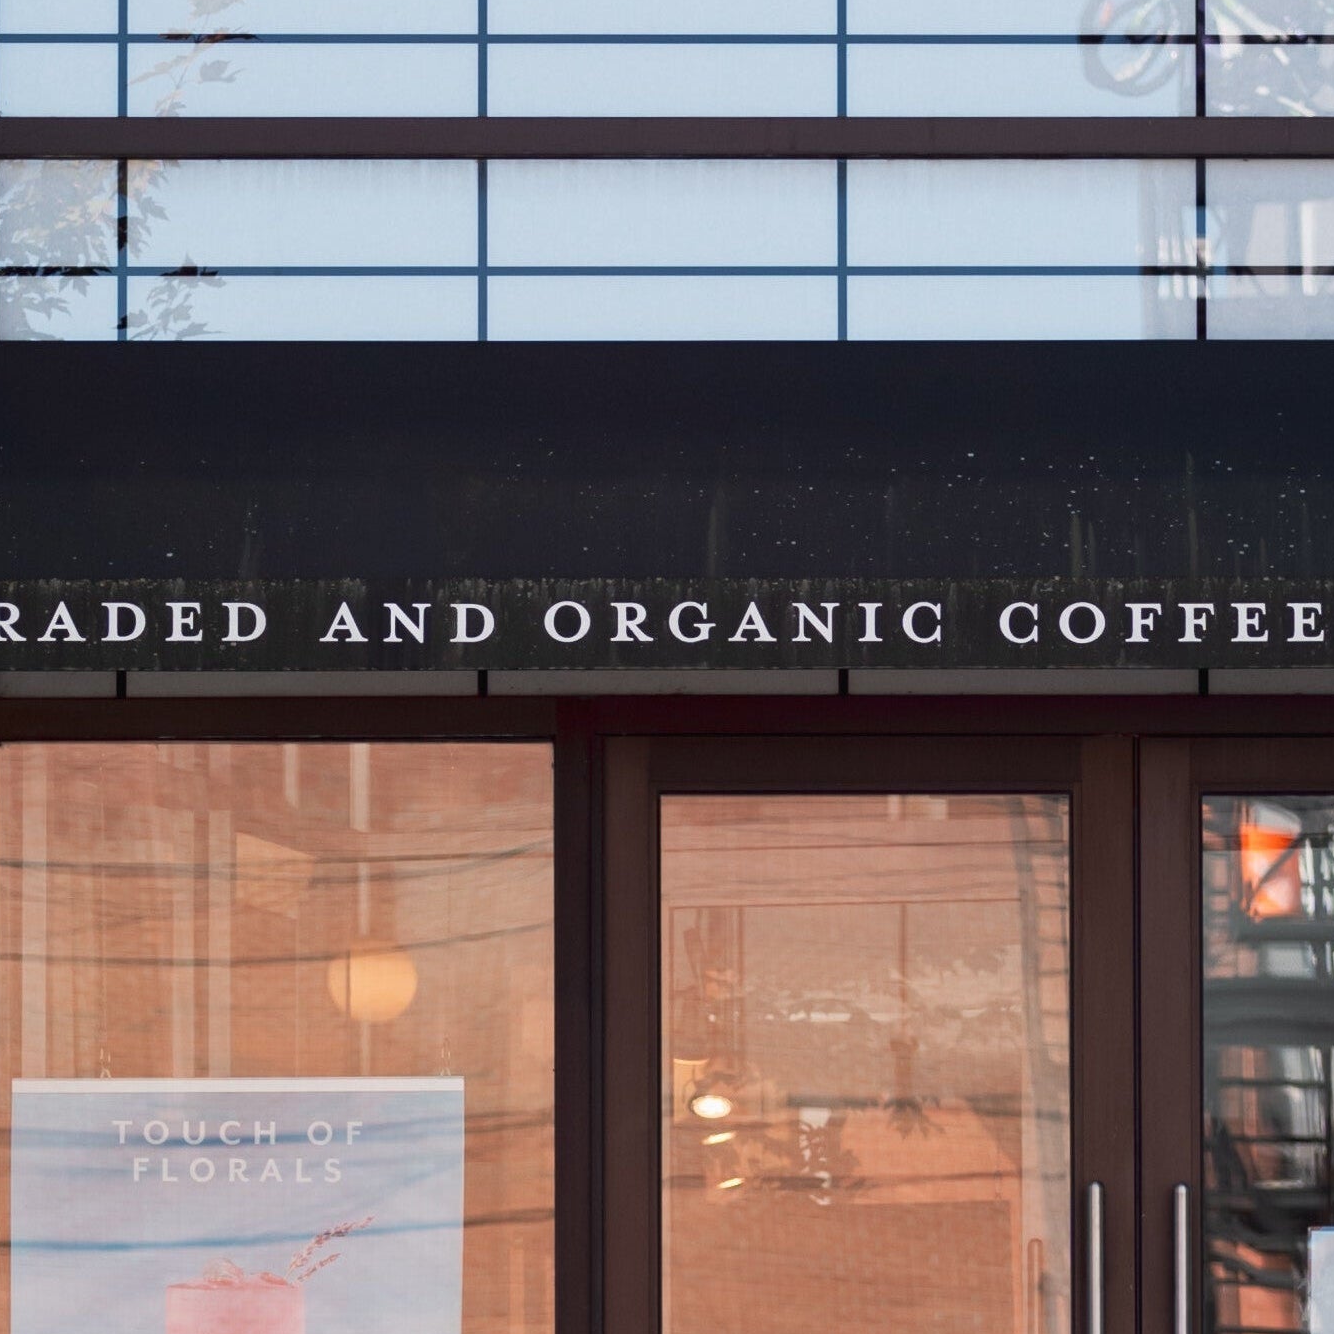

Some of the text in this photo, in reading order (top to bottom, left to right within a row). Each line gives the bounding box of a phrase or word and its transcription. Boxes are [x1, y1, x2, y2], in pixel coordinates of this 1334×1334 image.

[318, 601, 496, 644] AND
[543, 600, 942, 644] ORGANIC
[112, 1120, 365, 1146] TOUCH OF
[132, 1157, 344, 1184] FLORALS
